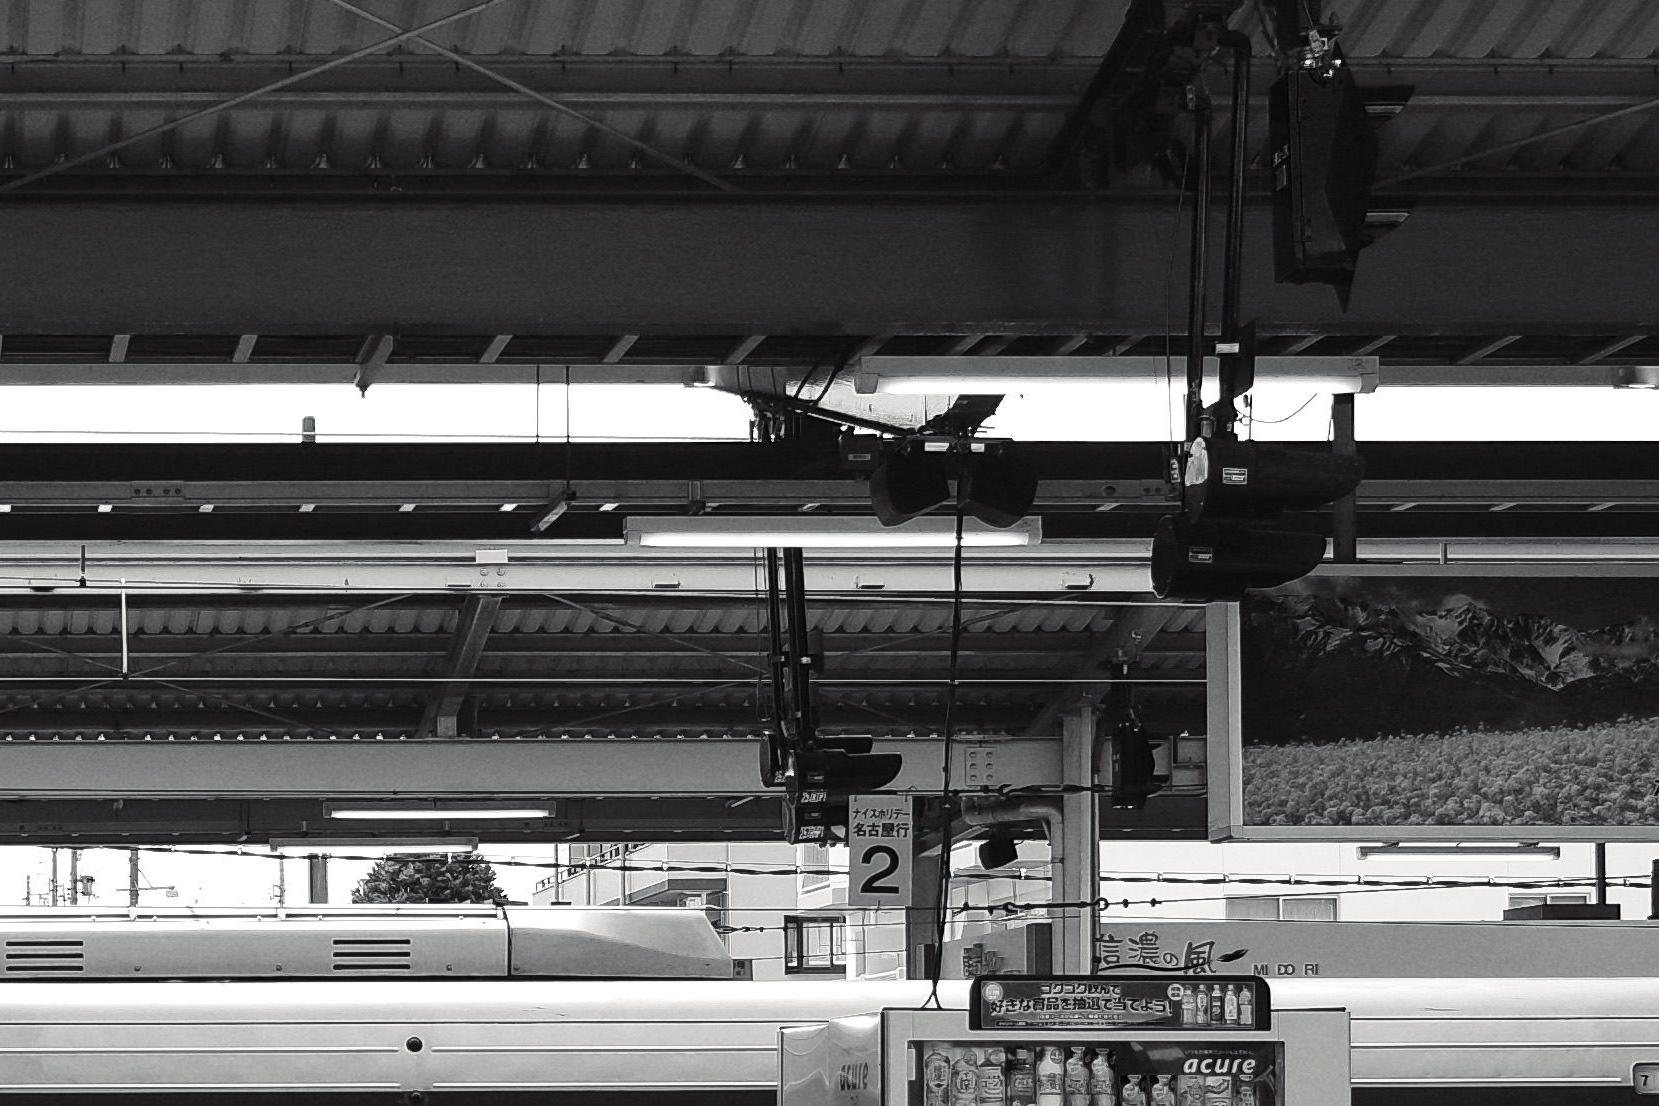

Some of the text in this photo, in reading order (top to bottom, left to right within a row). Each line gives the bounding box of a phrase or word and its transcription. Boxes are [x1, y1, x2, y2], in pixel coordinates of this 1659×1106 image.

[852, 807, 910, 820] ナイスホリデー
[852, 822, 910, 838] 名古屋行
[860, 845, 900, 894] 2
[1182, 1058, 1256, 1074] acure
[1640, 1074, 1649, 1087] 7
